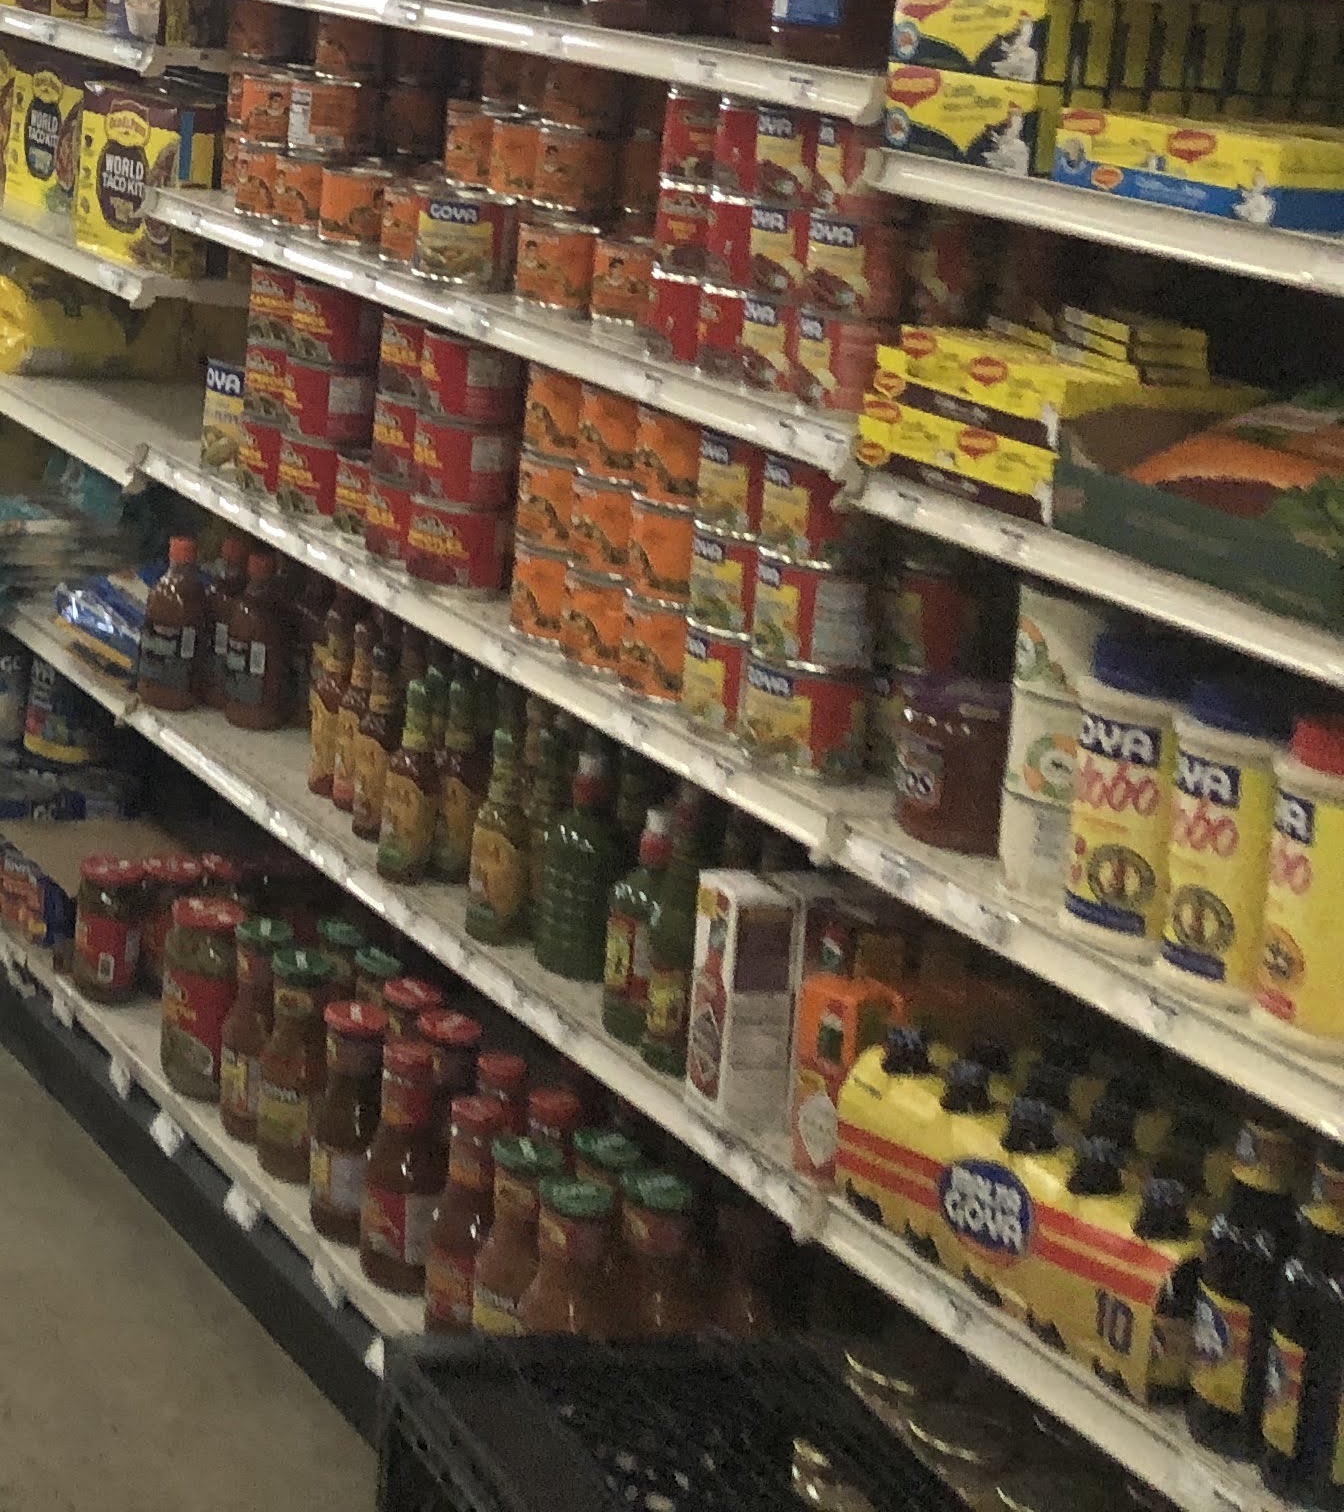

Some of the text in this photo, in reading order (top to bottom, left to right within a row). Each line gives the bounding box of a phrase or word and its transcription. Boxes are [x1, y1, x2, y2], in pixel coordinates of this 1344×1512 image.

[30, 108, 59, 134] WORLD
[28, 125, 60, 149] TACO KIT
[105, 153, 145, 180] WORLD
[102, 171, 145, 197] TACO KIT
[429, 202, 478, 223] GOYA
[943, 1190, 1024, 1256] GOYA
